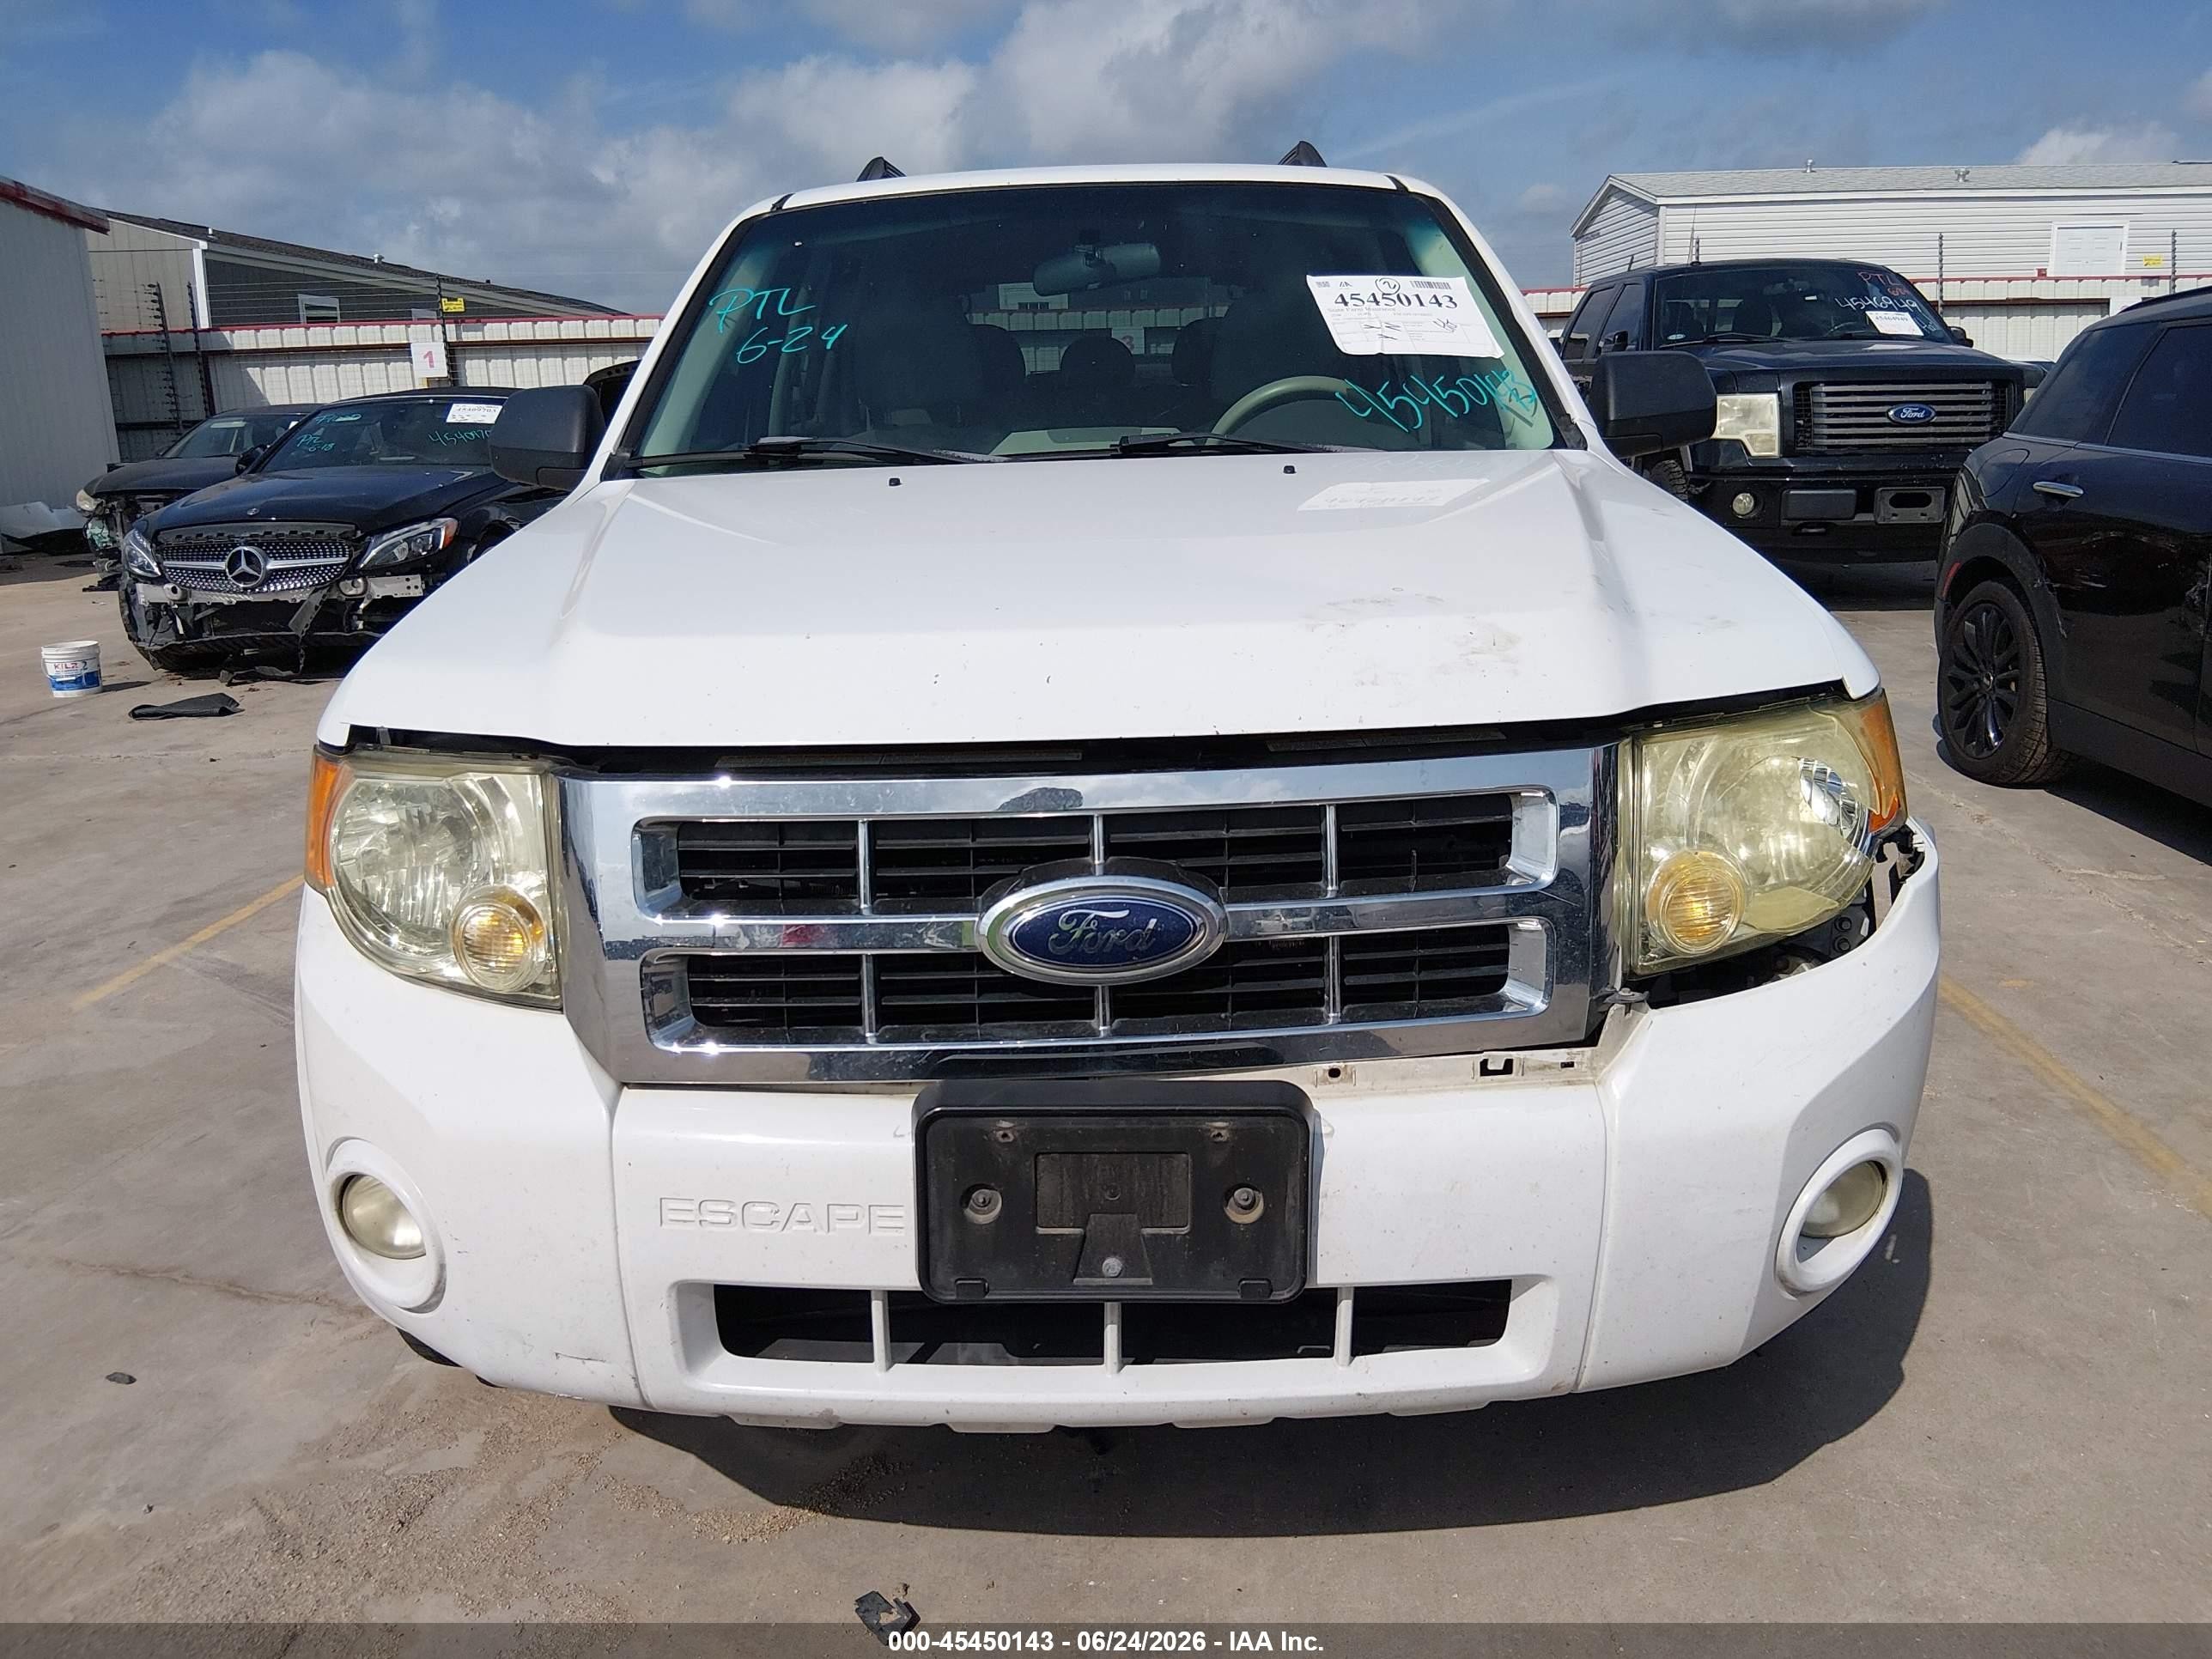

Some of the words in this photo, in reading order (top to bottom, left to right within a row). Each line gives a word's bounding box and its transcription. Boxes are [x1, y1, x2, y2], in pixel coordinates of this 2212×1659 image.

[1857, 272, 1904, 285] PTL
[708, 289, 817, 333] PTL
[1334, 293, 1457, 308] 45450143
[736, 324, 848, 364] 6-24
[423, 350, 434, 368] 1
[1900, 407, 1925, 418] Ford
[1048, 909, 1158, 956] Ford
[659, 1197, 907, 1234] ESCAPE
